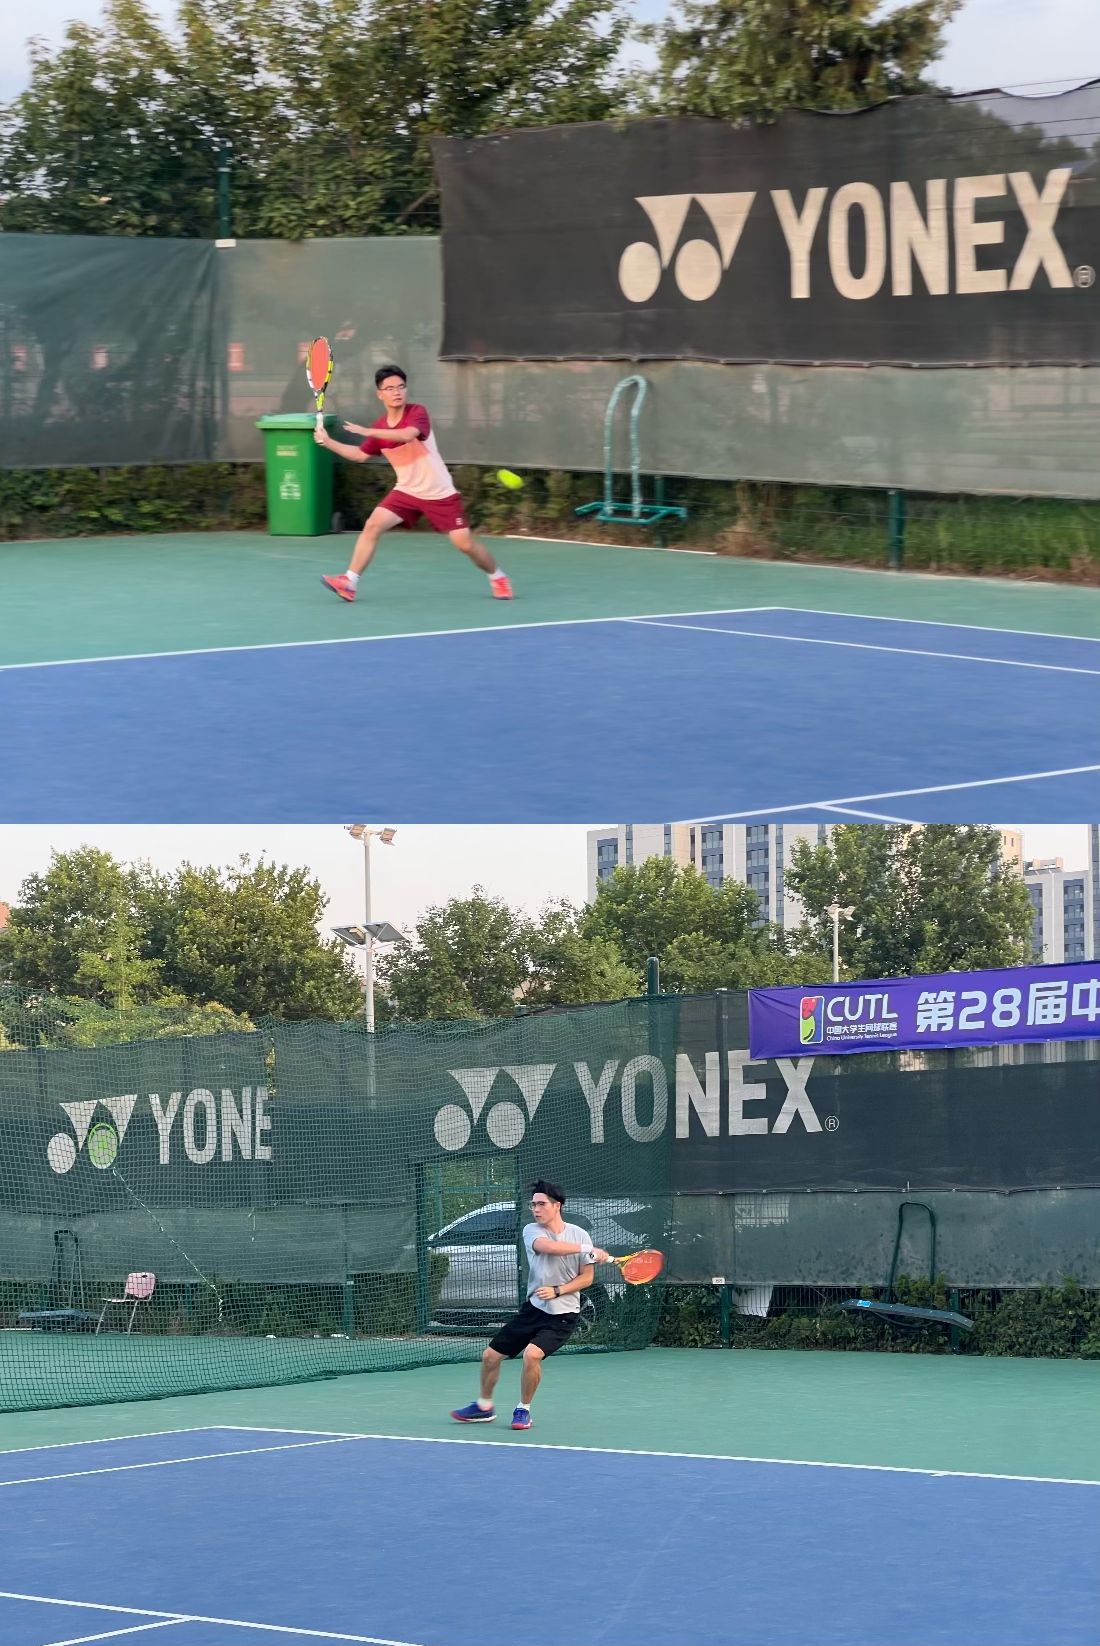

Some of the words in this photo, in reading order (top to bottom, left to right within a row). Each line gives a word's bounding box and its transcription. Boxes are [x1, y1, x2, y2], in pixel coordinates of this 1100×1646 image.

[770, 168, 1075, 299] YONEX
[827, 993, 898, 1021] CUTL
[573, 1050, 823, 1144] YONEX
